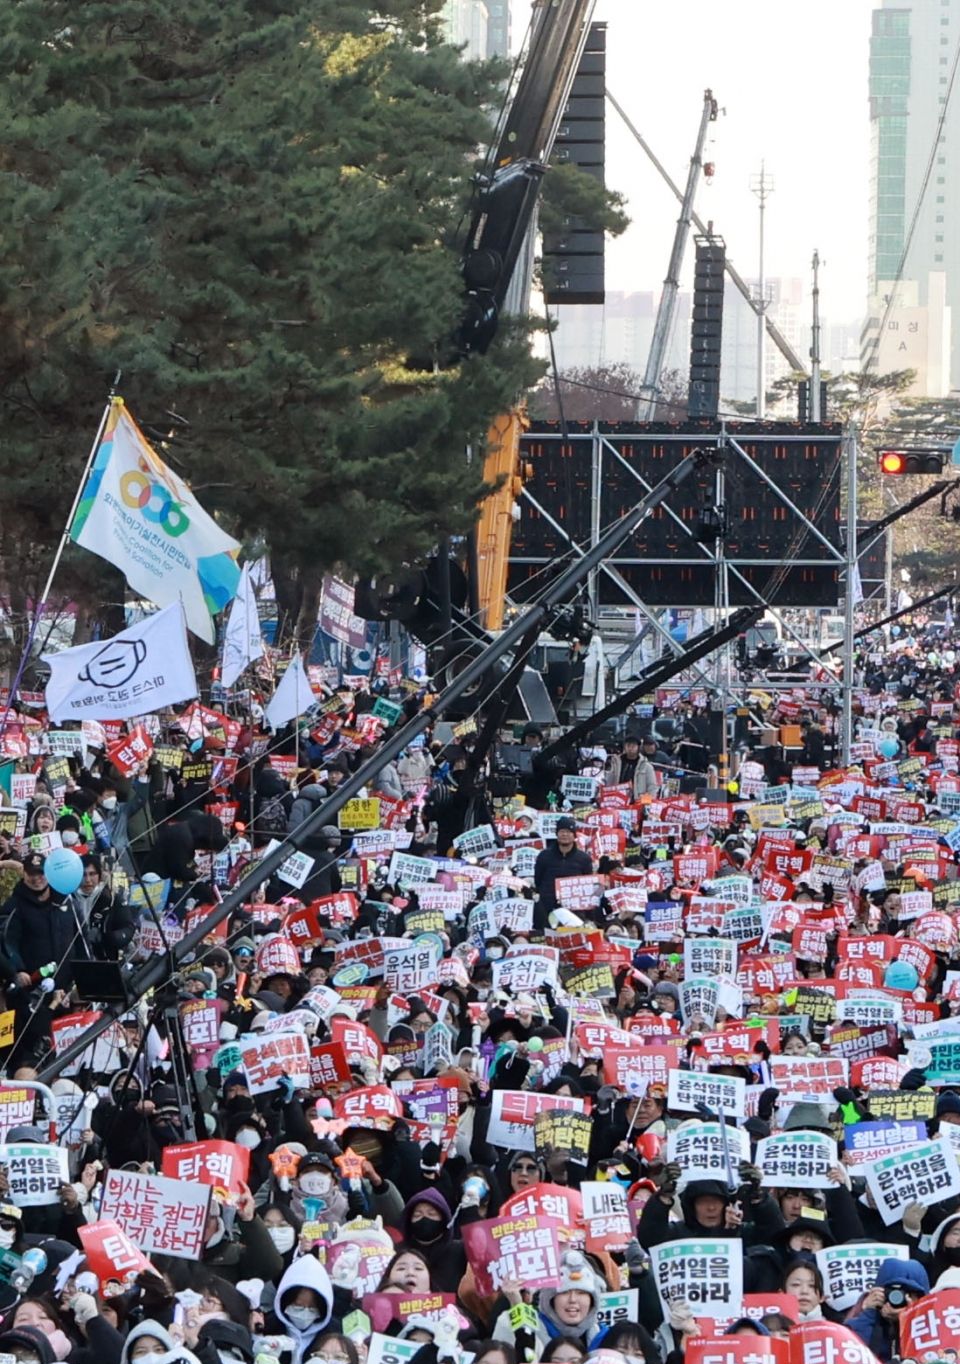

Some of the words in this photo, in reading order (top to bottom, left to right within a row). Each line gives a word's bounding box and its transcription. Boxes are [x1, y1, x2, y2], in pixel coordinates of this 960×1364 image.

[775, 855, 804, 872] 탄핵
[846, 938, 885, 960] 탄핵
[386, 952, 431, 975] 윤석열
[499, 960, 548, 977] 윤석열
[385, 973, 422, 992] 퇴진!
[499, 975, 538, 991] 퇴진!
[737, 971, 776, 992] 탄핵
[584, 1026, 632, 1048] 탄핵
[704, 1031, 750, 1053] 탄핵
[343, 1094, 395, 1117] 탄핵
[764, 1142, 830, 1161] 윤석열을
[177, 1150, 234, 1186] 탄핵
[762, 1160, 833, 1178] 탄핵하라
[877, 1152, 948, 1191] 윤석열을
[107, 1175, 164, 1202] 역사는
[882, 1173, 952, 1211] 탄핵하라
[102, 1199, 158, 1228] 너희를
[161, 1203, 206, 1228] 절대
[490, 1216, 538, 1239] 반란수괴
[152, 1227, 203, 1255] 않는다
[499, 1233, 554, 1256] 윤석열
[658, 1255, 731, 1283] 윤석열을
[661, 1280, 732, 1305] 탄핵하라
